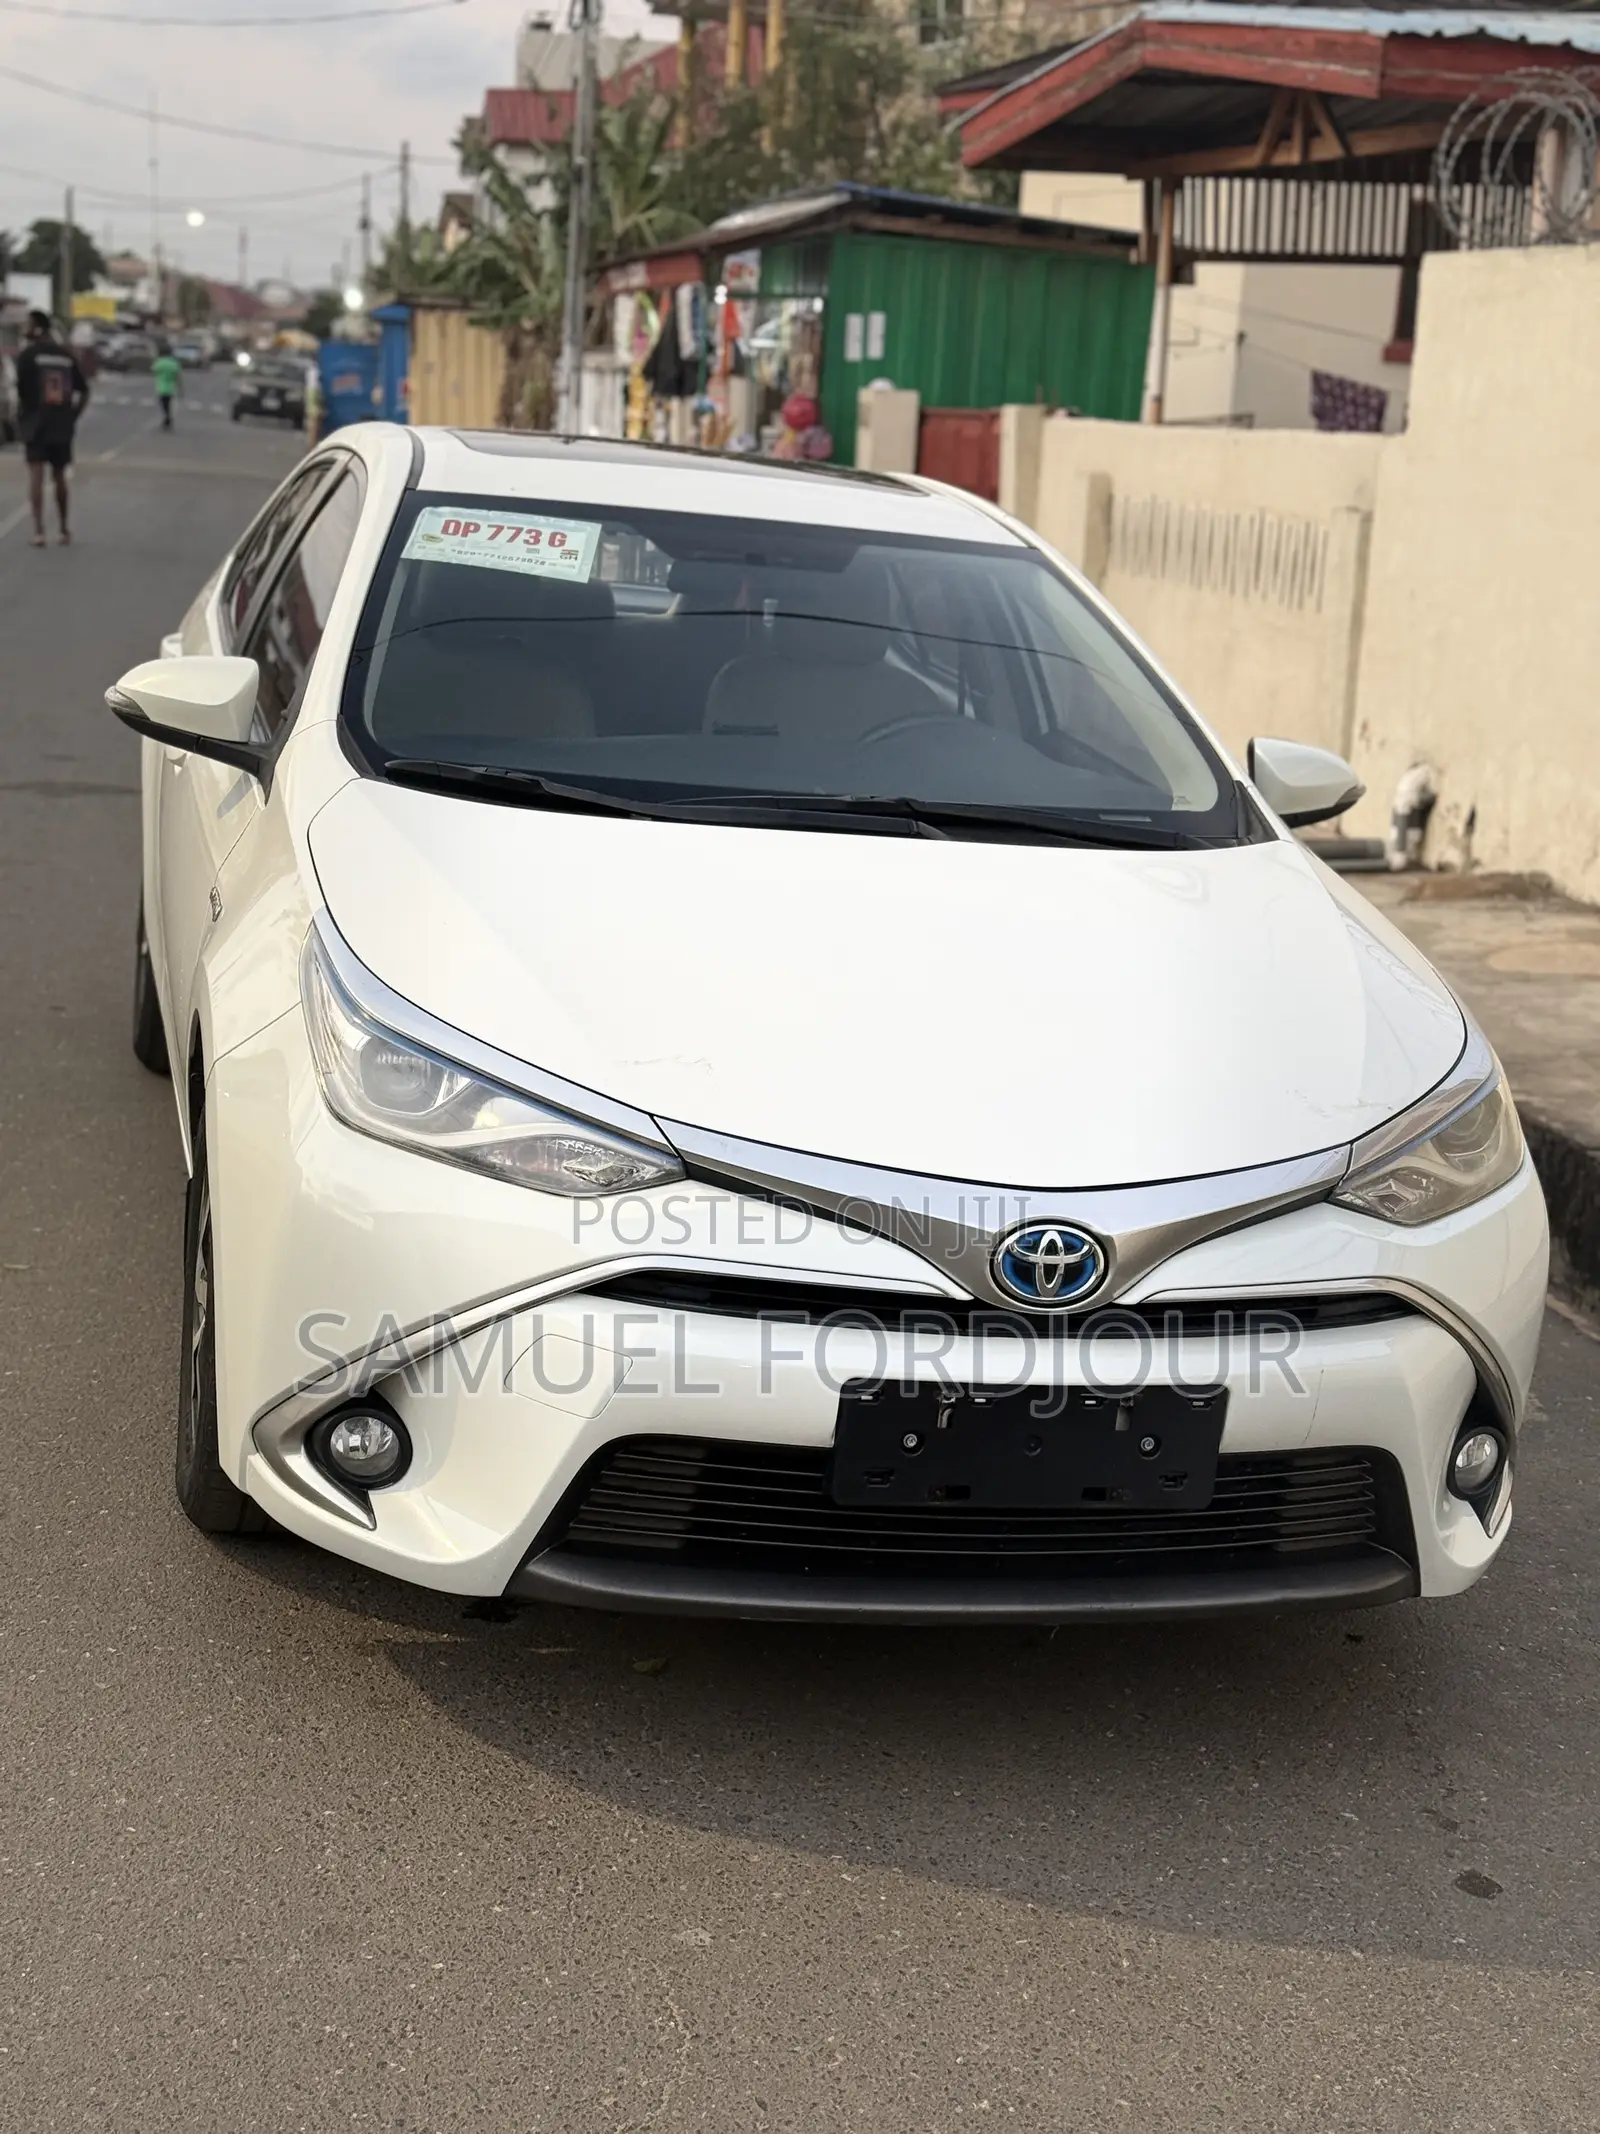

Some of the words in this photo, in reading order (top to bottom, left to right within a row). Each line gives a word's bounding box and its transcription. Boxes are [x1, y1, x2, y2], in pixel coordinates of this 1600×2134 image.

[440, 519, 481, 538] DP
[487, 524, 543, 546] 773
[547, 531, 568, 548] G
